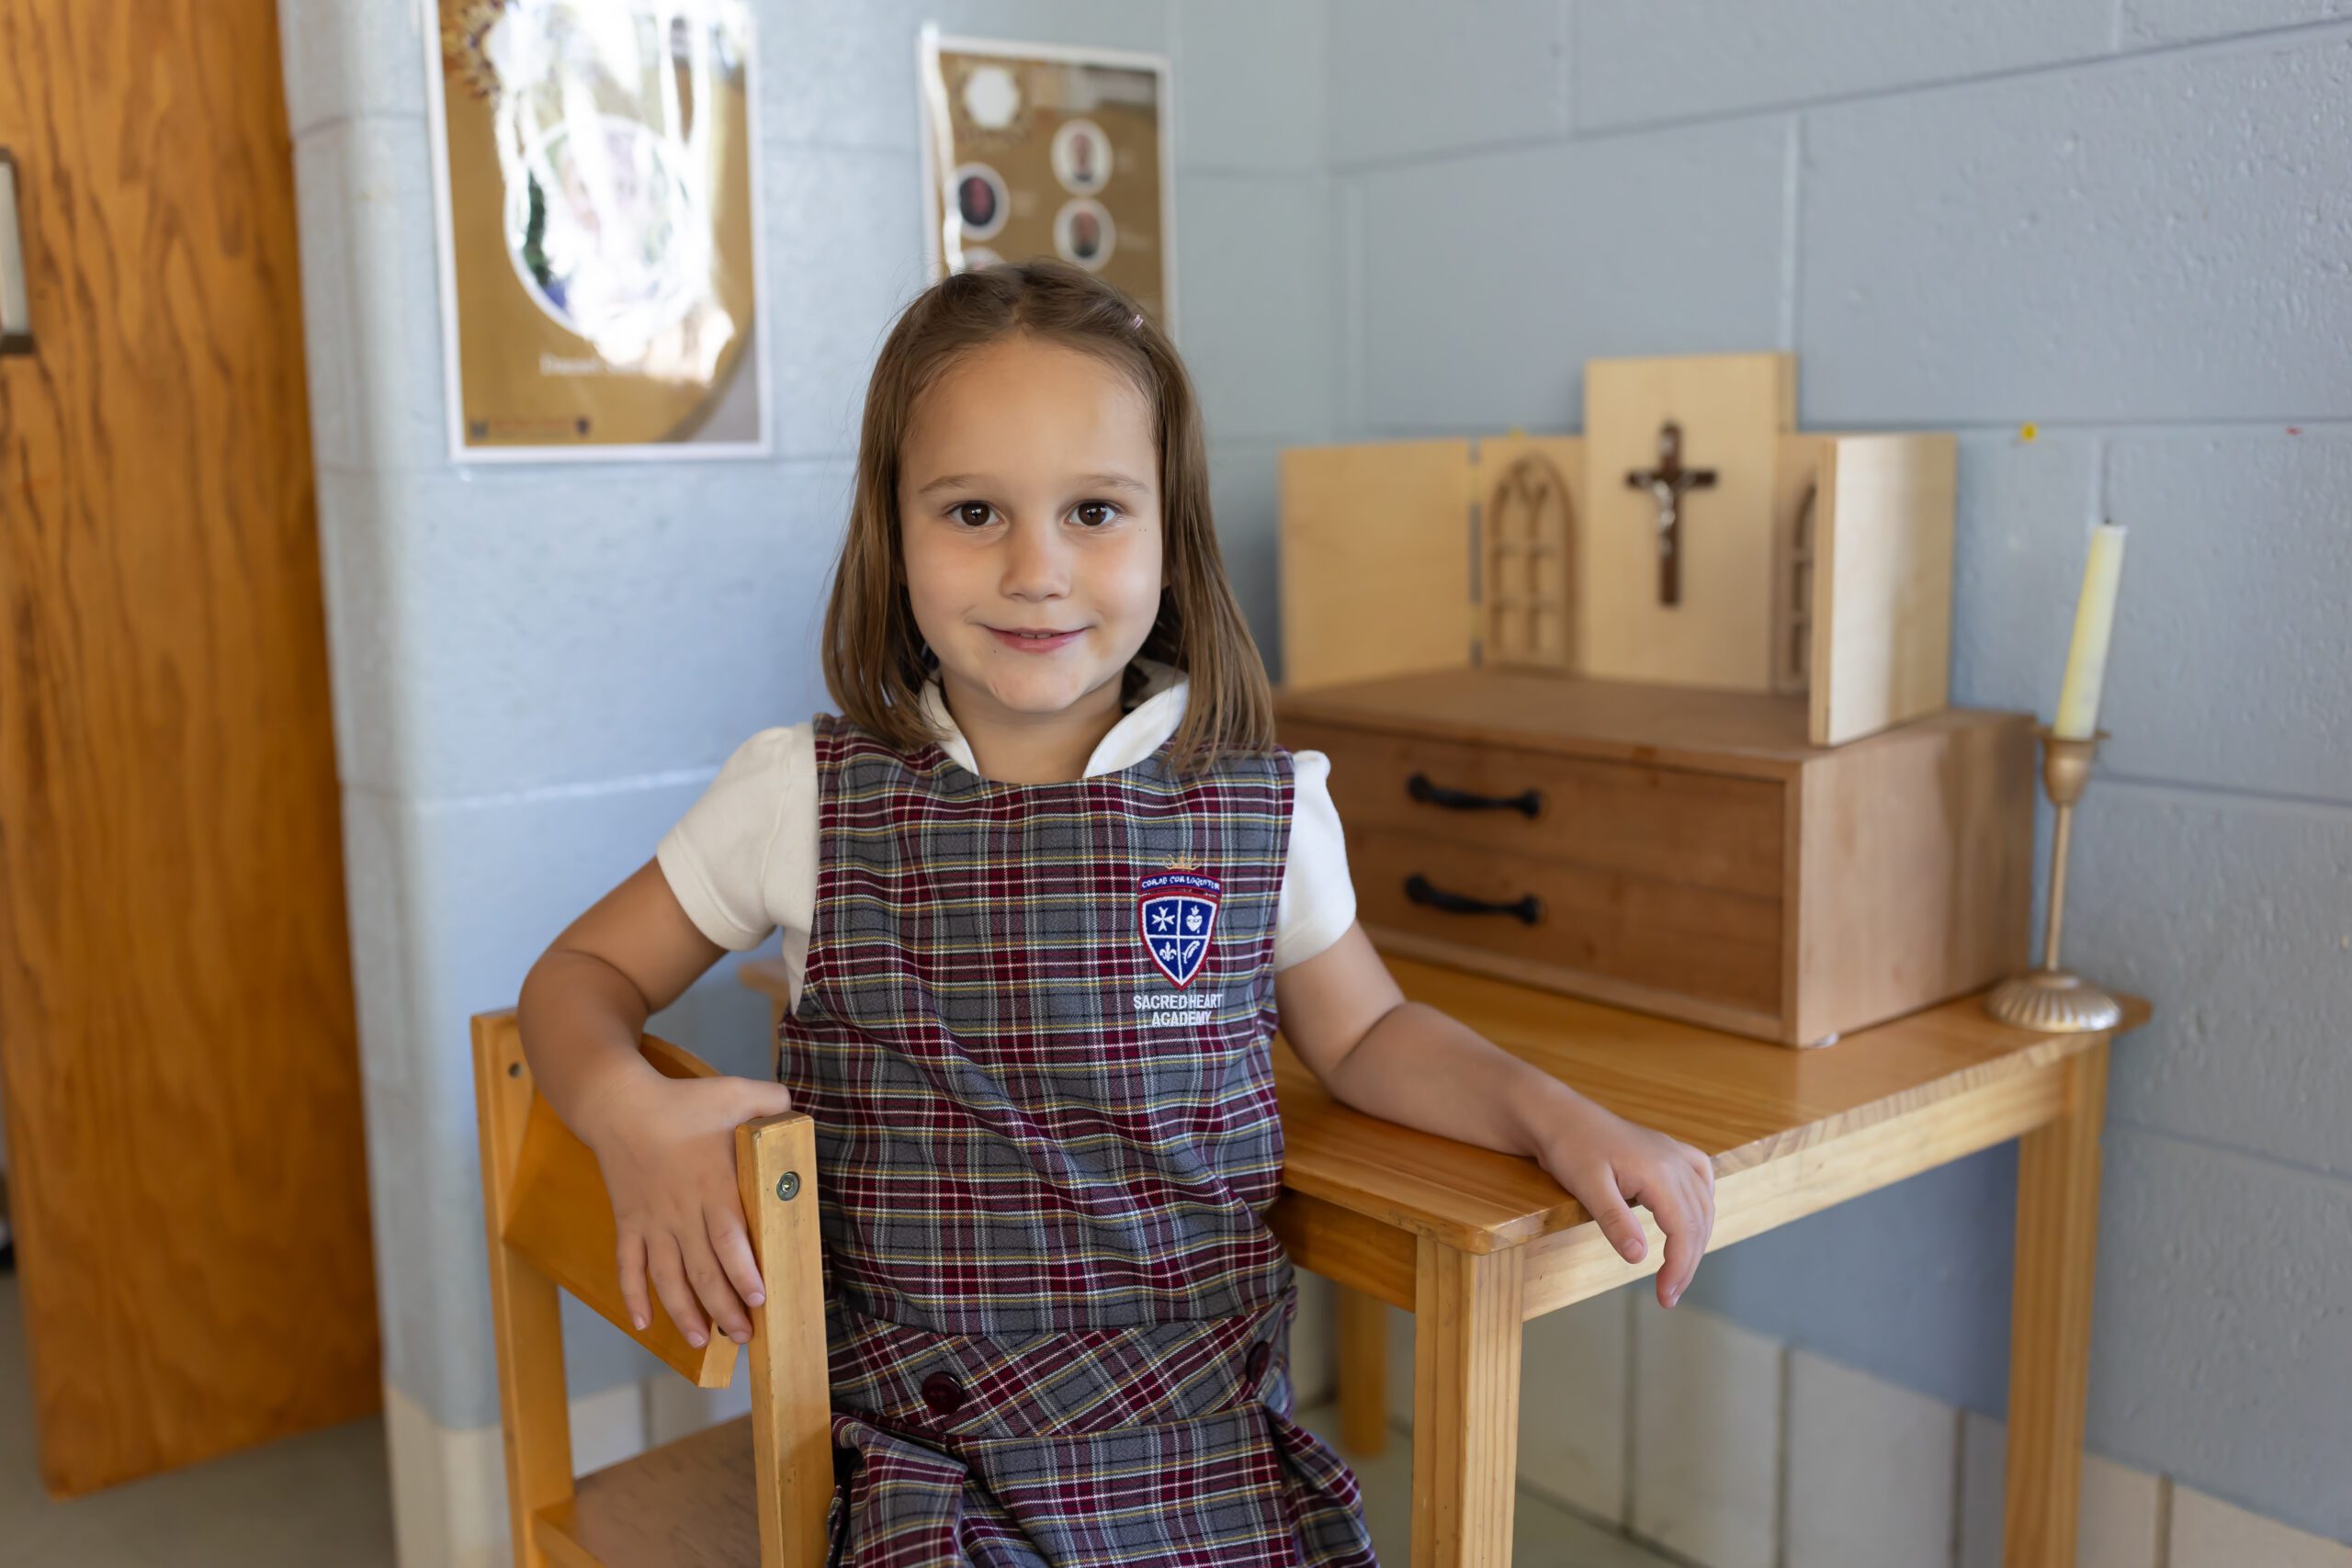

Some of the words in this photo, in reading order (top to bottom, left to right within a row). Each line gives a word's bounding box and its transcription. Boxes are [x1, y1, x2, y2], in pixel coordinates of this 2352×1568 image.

[1170, 875, 1185, 884] COR
[1133, 994, 1188, 1010] SACRED
[1189, 993, 1223, 1009] HEART
[1151, 1010, 1212, 1027] ACADEMY
